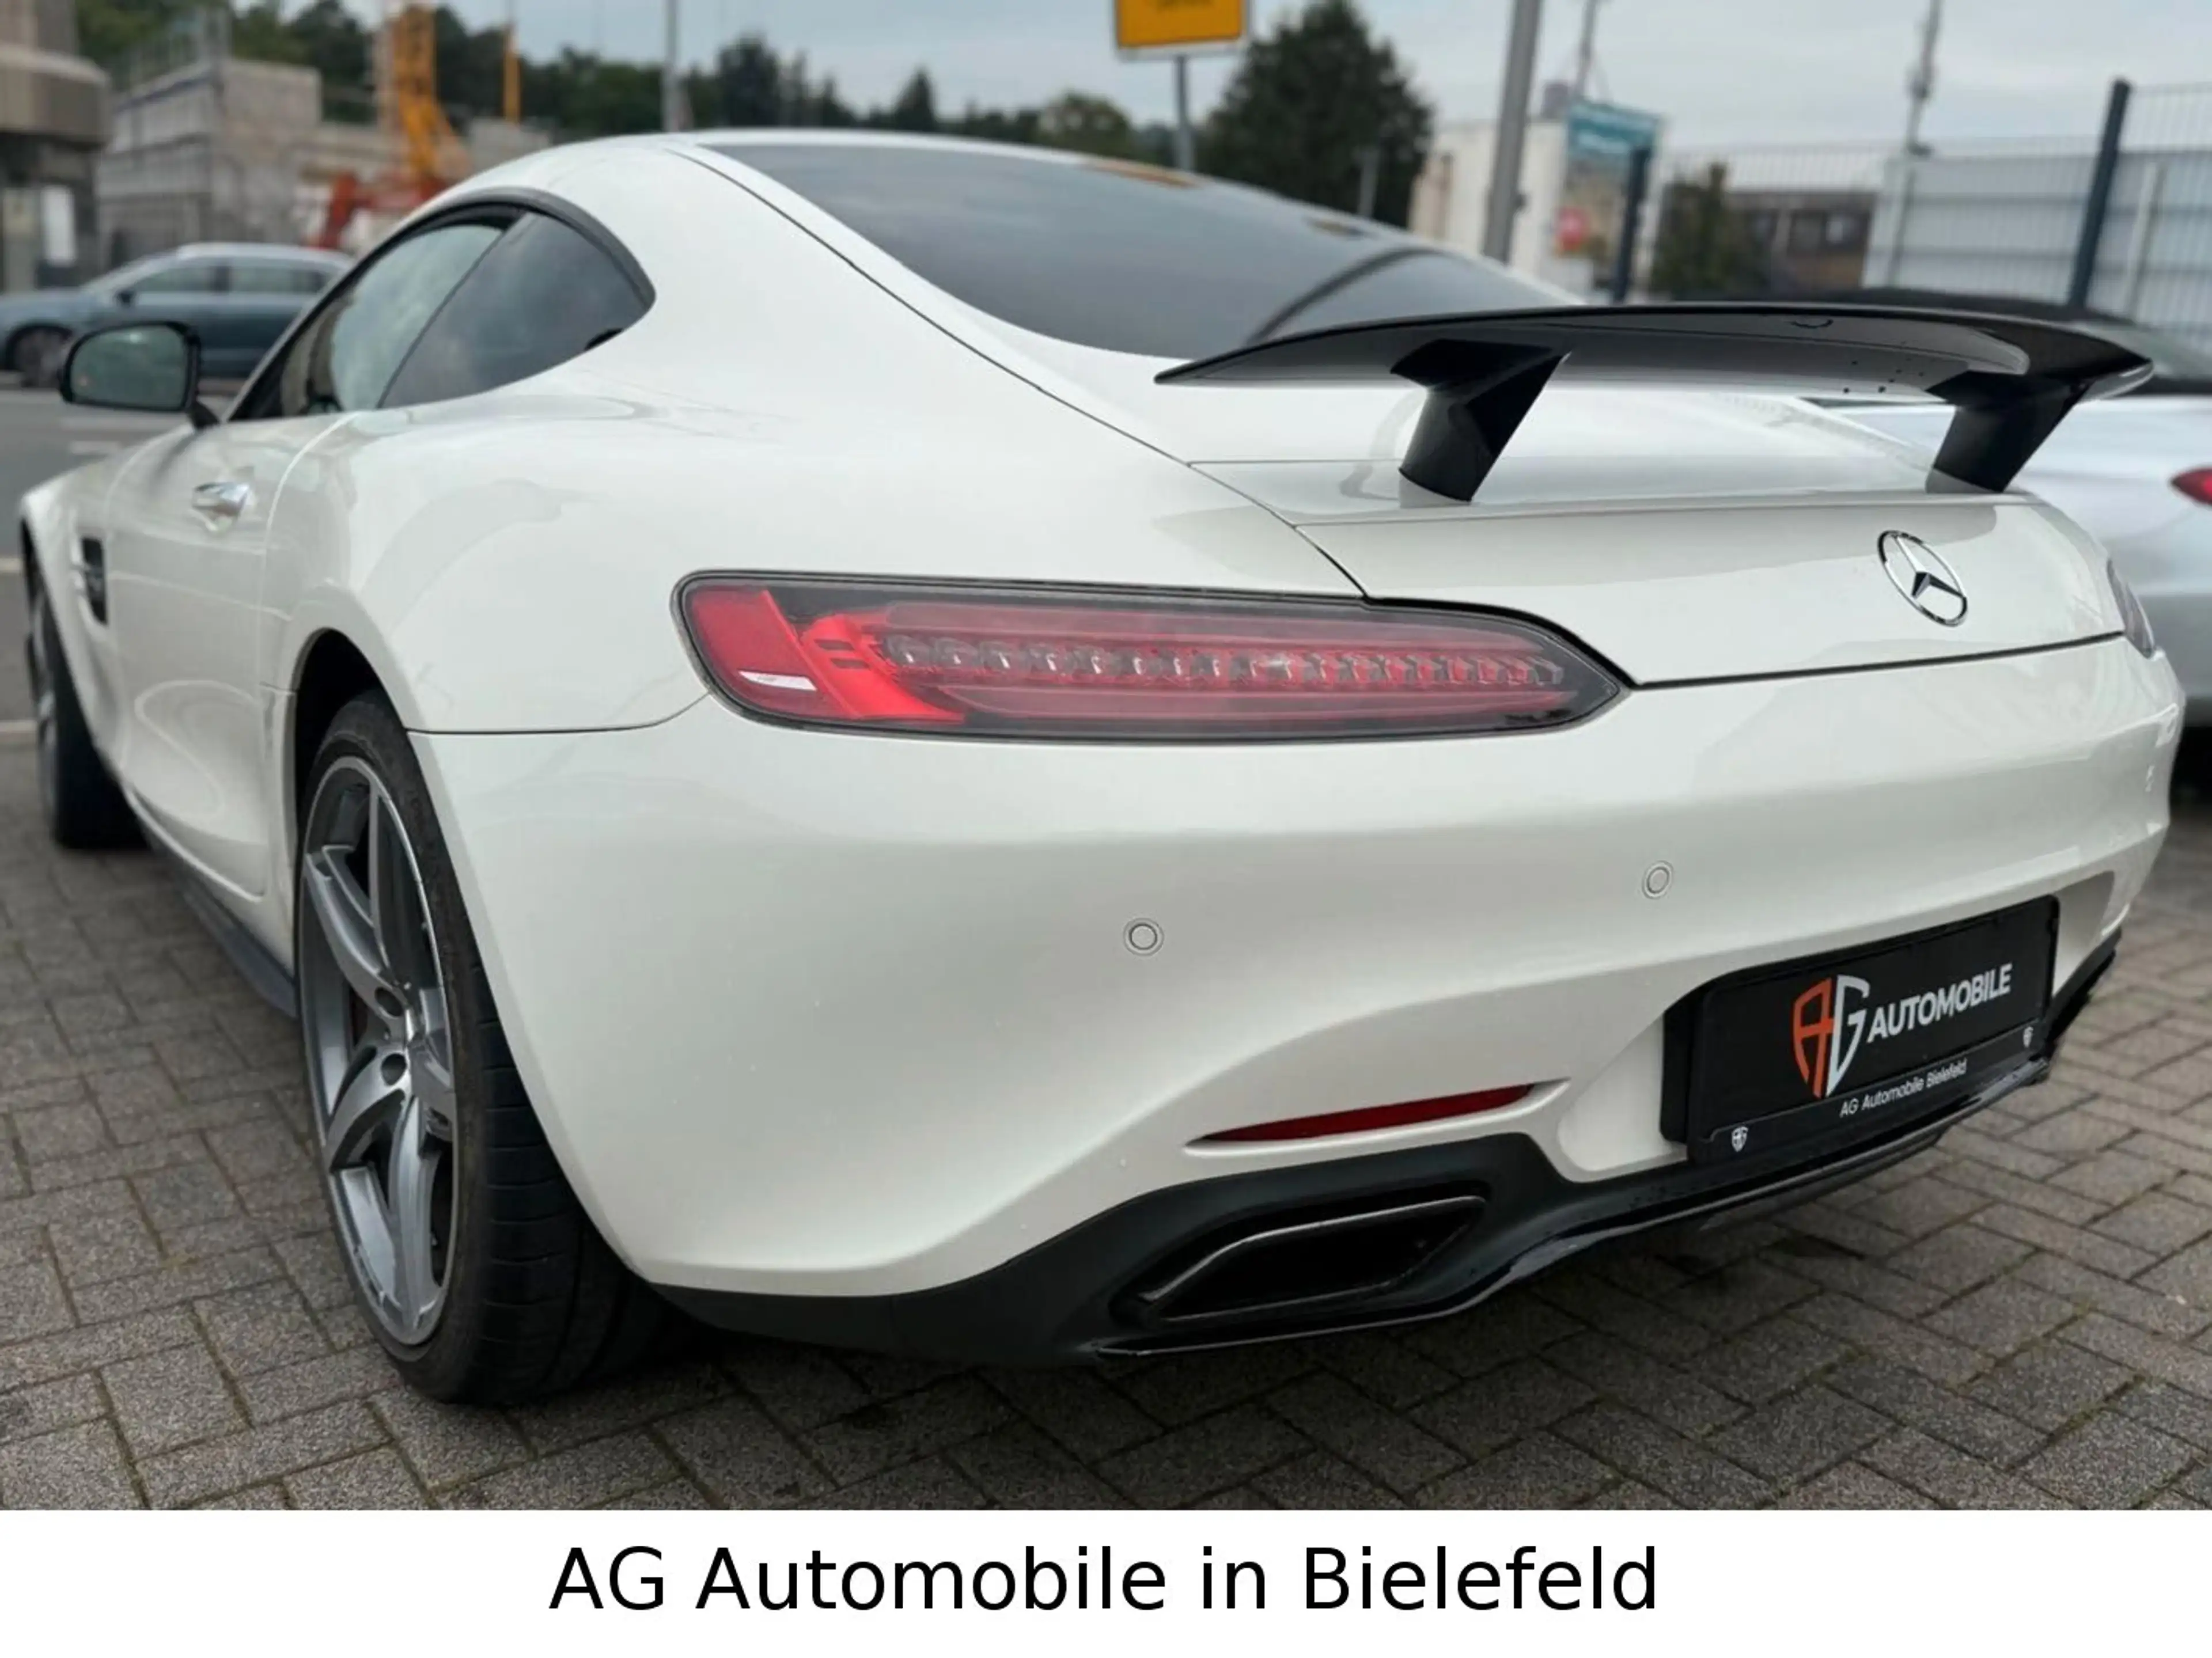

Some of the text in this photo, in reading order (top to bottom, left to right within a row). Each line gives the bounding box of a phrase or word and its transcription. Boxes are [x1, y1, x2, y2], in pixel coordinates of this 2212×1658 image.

[1866, 963, 2013, 1043] AUTOMOBILE
[1839, 1057, 1968, 1118] AG Automobile Bielefeld
